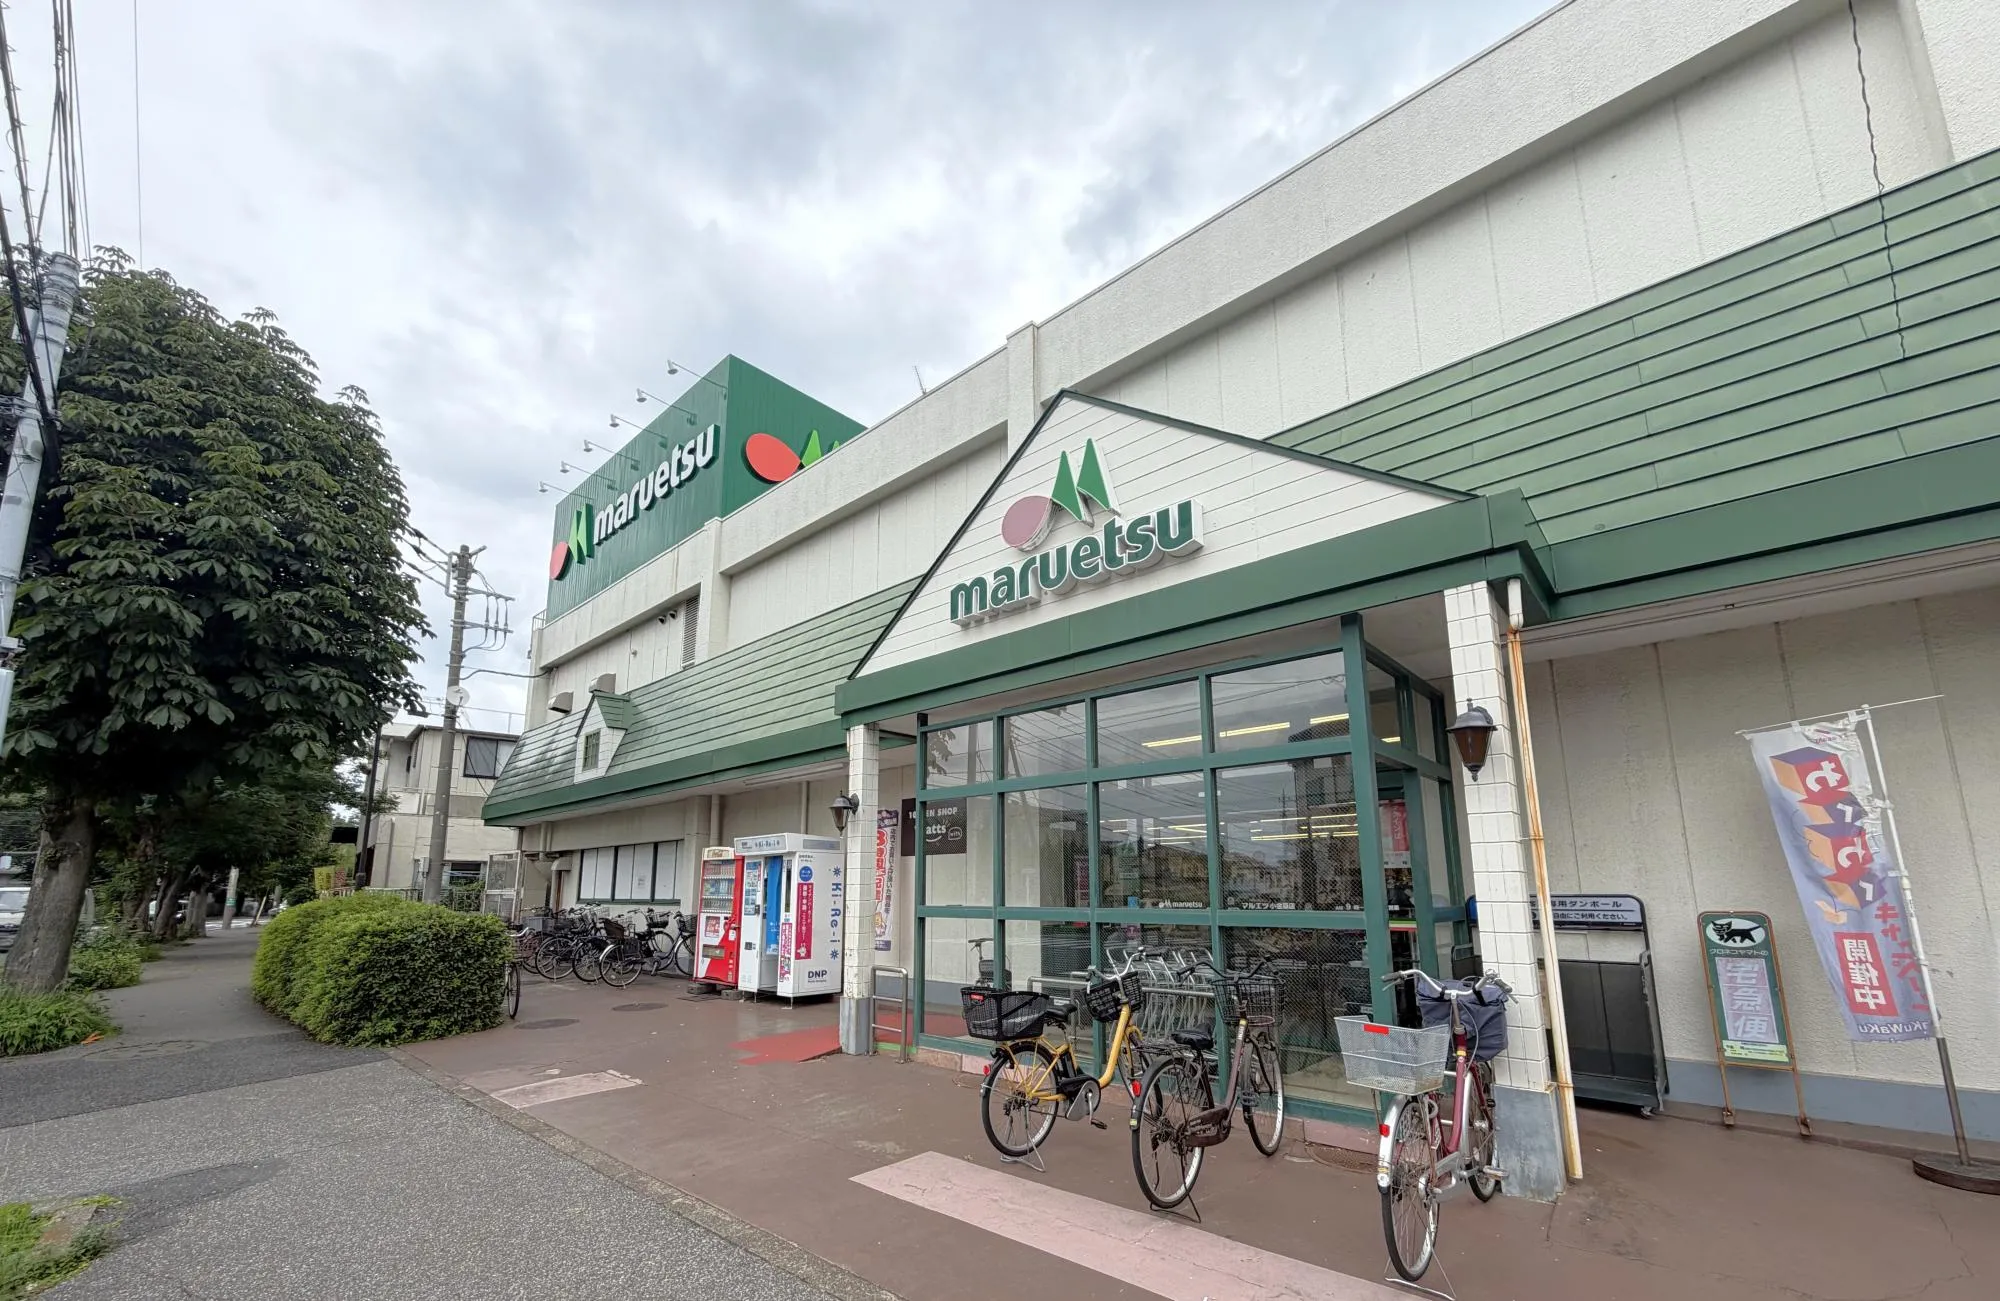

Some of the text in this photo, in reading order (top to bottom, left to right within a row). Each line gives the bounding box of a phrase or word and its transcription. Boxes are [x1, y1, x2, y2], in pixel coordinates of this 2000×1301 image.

[593, 424, 718, 544] maruetsu
[950, 499, 1197, 624] maruetsu
[937, 807, 958, 817] SHOP
[808, 969, 828, 979] DNP
[1709, 948, 1768, 956] クロネコヤマトの
[1726, 961, 1769, 1039] 宅急便
